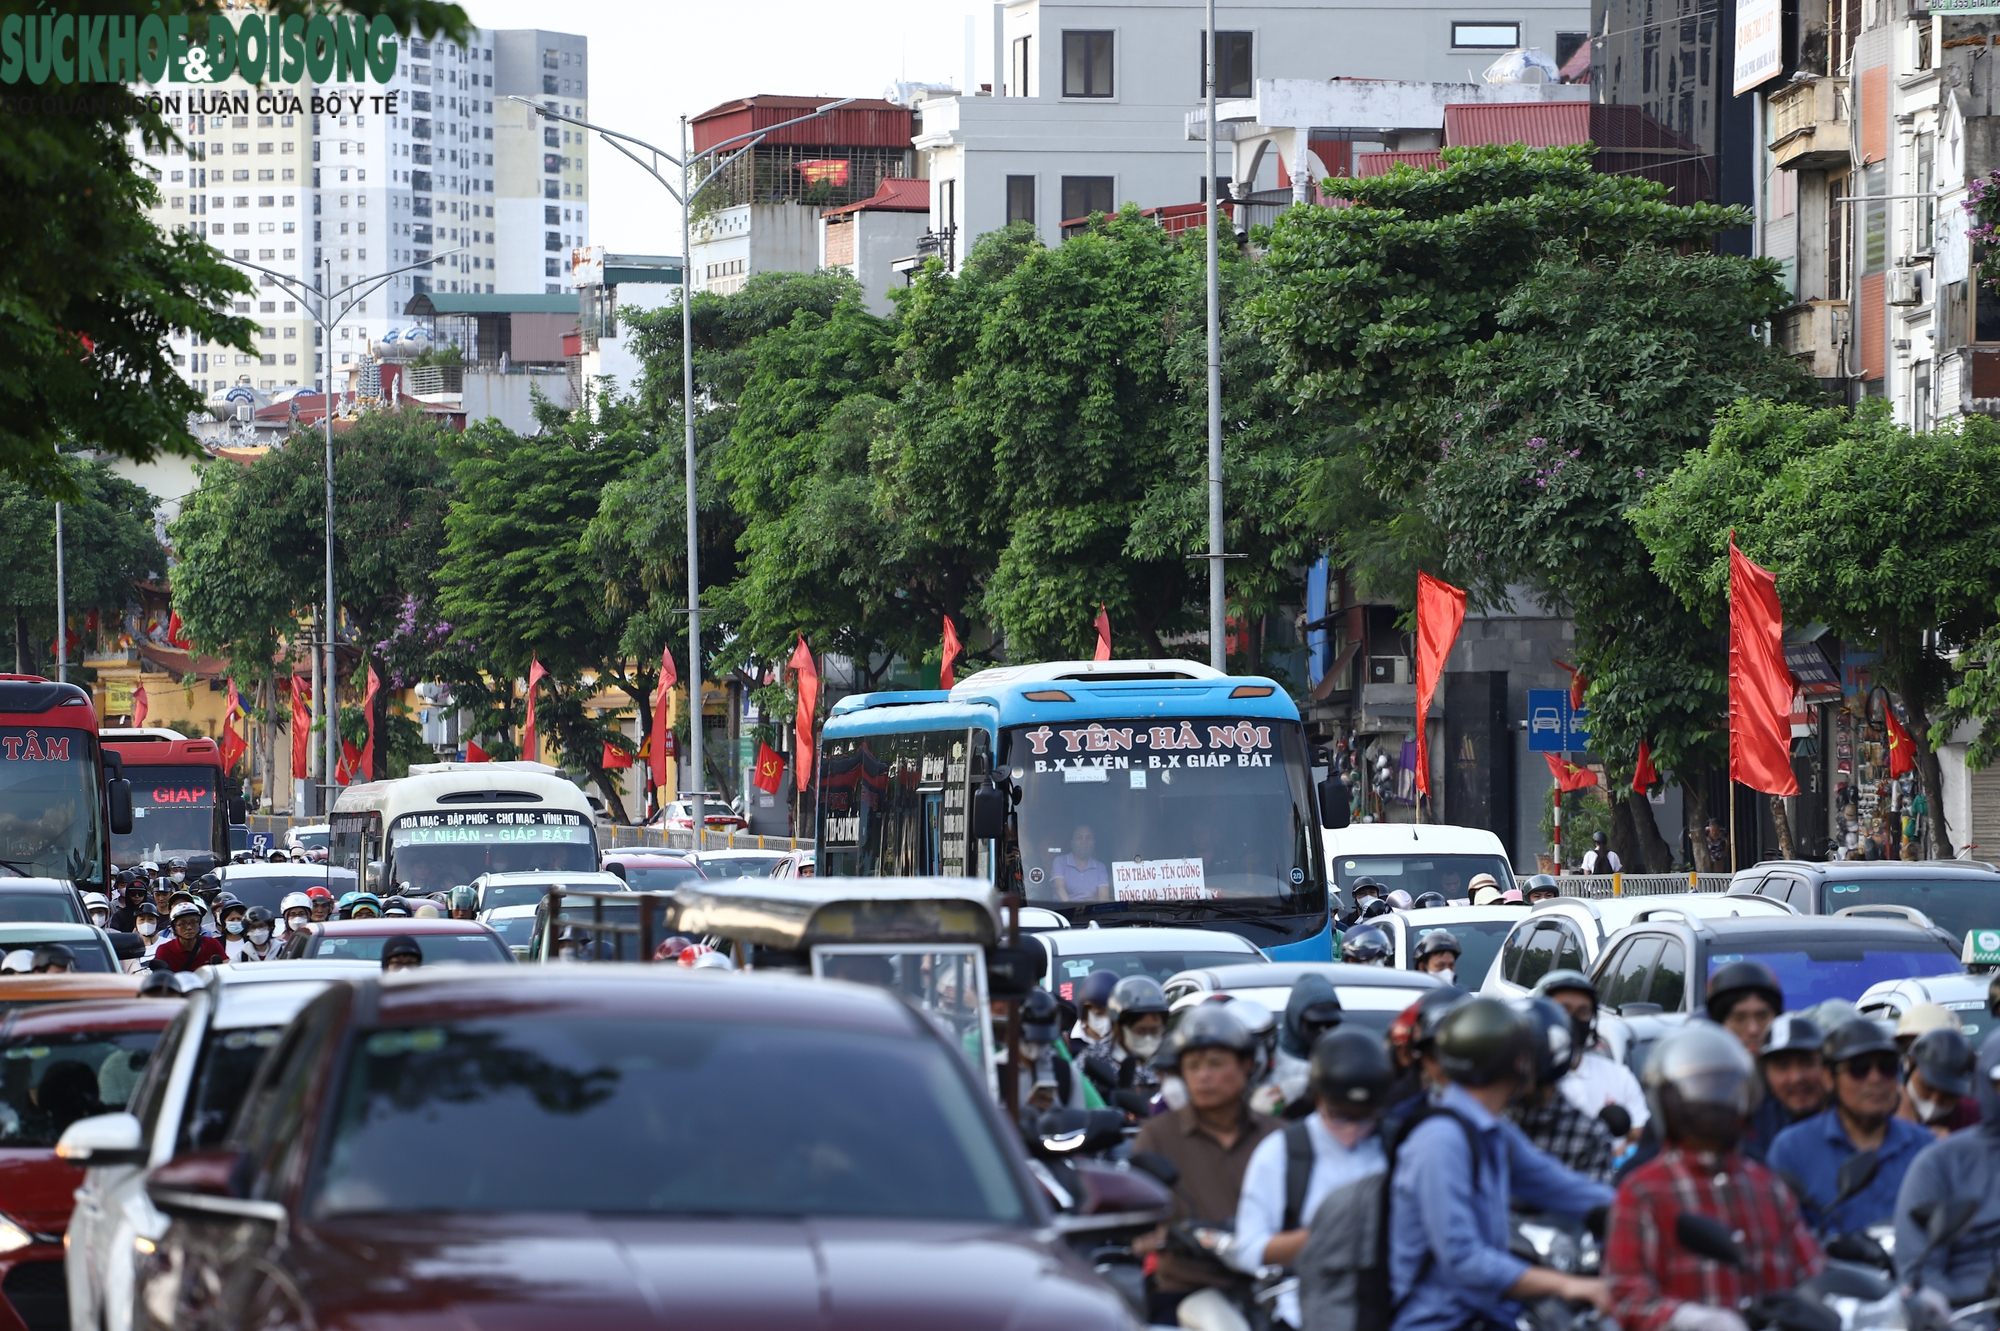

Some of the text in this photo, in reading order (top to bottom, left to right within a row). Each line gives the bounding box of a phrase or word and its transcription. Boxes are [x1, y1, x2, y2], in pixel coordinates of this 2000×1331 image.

[2, 730, 70, 761] TÂM
[1026, 726, 1053, 754] Ý
[1207, 720, 1272, 753] NỘI
[1034, 758, 1066, 774] B.X
[1073, 755, 1086, 772] Ý
[1091, 754, 1129, 770] YÊN
[1148, 755, 1180, 769] B.X
[1186, 751, 1231, 768] GIÁP
[1237, 751, 1273, 767] BÁT
[400, 815, 418, 829] HOÀ
[420, 814, 440, 829] MẠC
[447, 812, 465, 828] ĐẬP
[465, 812, 489, 825] PHÚC
[496, 812, 514, 826] CHỢ
[516, 812, 536, 827] MẠC
[542, 812, 563, 825] VĨNH
[411, 829, 430, 842] LÝ
[434, 828, 480, 842] NHÂN
[498, 827, 537, 841] GIÁP
[542, 827, 573, 841] BÁT
[1116, 865, 1132, 882] YÊN
[1292, 872, 1302, 880] 2/3
[1141, 888, 1158, 901] CAO
